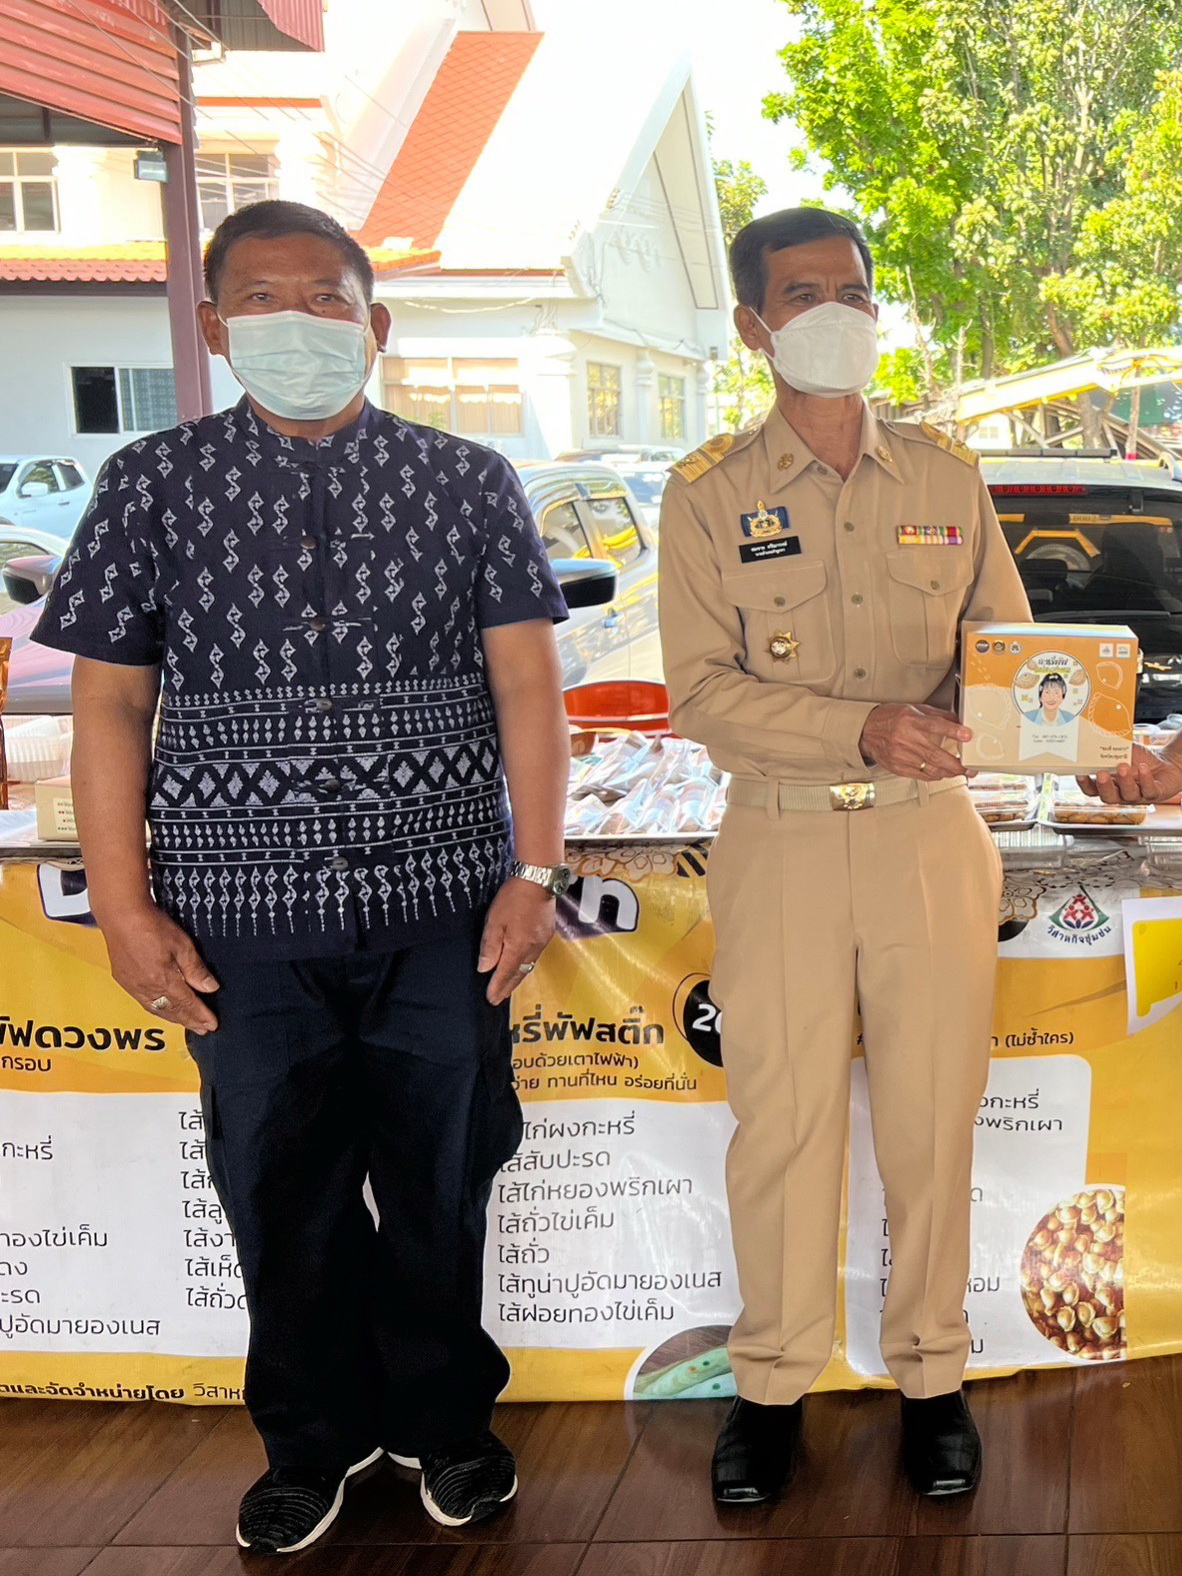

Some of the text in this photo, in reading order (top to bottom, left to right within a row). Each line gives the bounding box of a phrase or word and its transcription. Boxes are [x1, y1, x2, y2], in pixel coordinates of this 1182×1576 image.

[1047, 924, 1111, 946] วิสาหกิจชุมชน
[1005, 1027, 1075, 1048] (ไม่ซ้ำใคร)
[2, 1056, 51, 1072] กรอบ
[547, 1069, 618, 1089] ทานที่ไหน
[624, 1072, 697, 1091] อร่อยที่นั่น
[523, 1110, 635, 1141] ไก่ผงกะหรี่
[2, 1135, 53, 1160] กะหรี่
[498, 1176, 693, 1204] ไส้ไก่หยองพริกเผา
[498, 1205, 614, 1235] ไส้ถั่วไข่เค็ม
[498, 1238, 550, 1264] ไส้ถั่ว
[498, 1271, 722, 1299] ไส้ทูน่าปูอัดมายองเนส
[498, 1298, 675, 1323] ไส้ฝอยทองไข่เค็ม
[0, 1313, 161, 1339] ปูอัดมายองเนส
[193, 1383, 246, 1400] วิสาห
